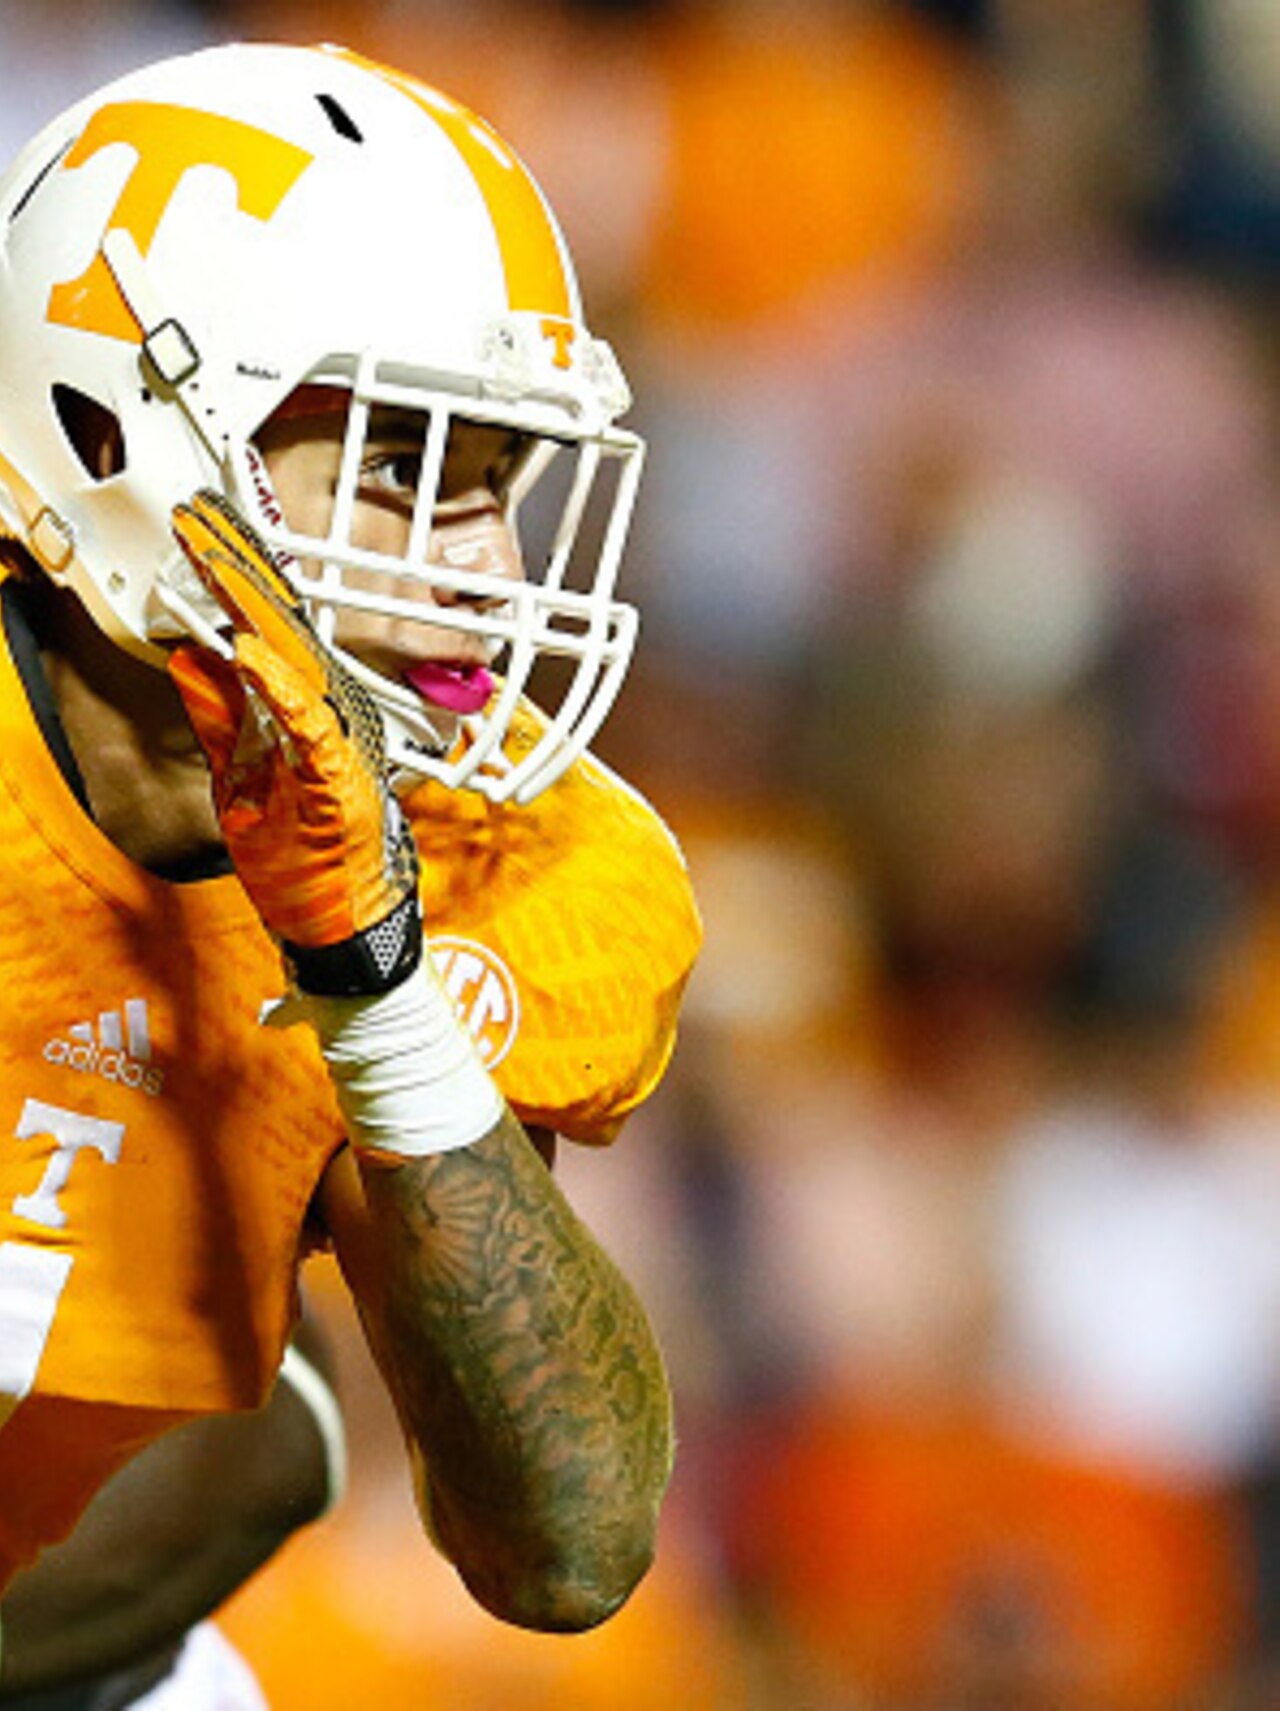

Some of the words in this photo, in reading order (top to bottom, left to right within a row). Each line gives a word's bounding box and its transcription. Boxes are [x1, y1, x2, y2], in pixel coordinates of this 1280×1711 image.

[46, 99, 315, 344] T
[539, 319, 575, 370] T
[430, 949, 508, 1057] EC
[43, 1037, 165, 1096] adidas
[12, 1097, 125, 1230] T
